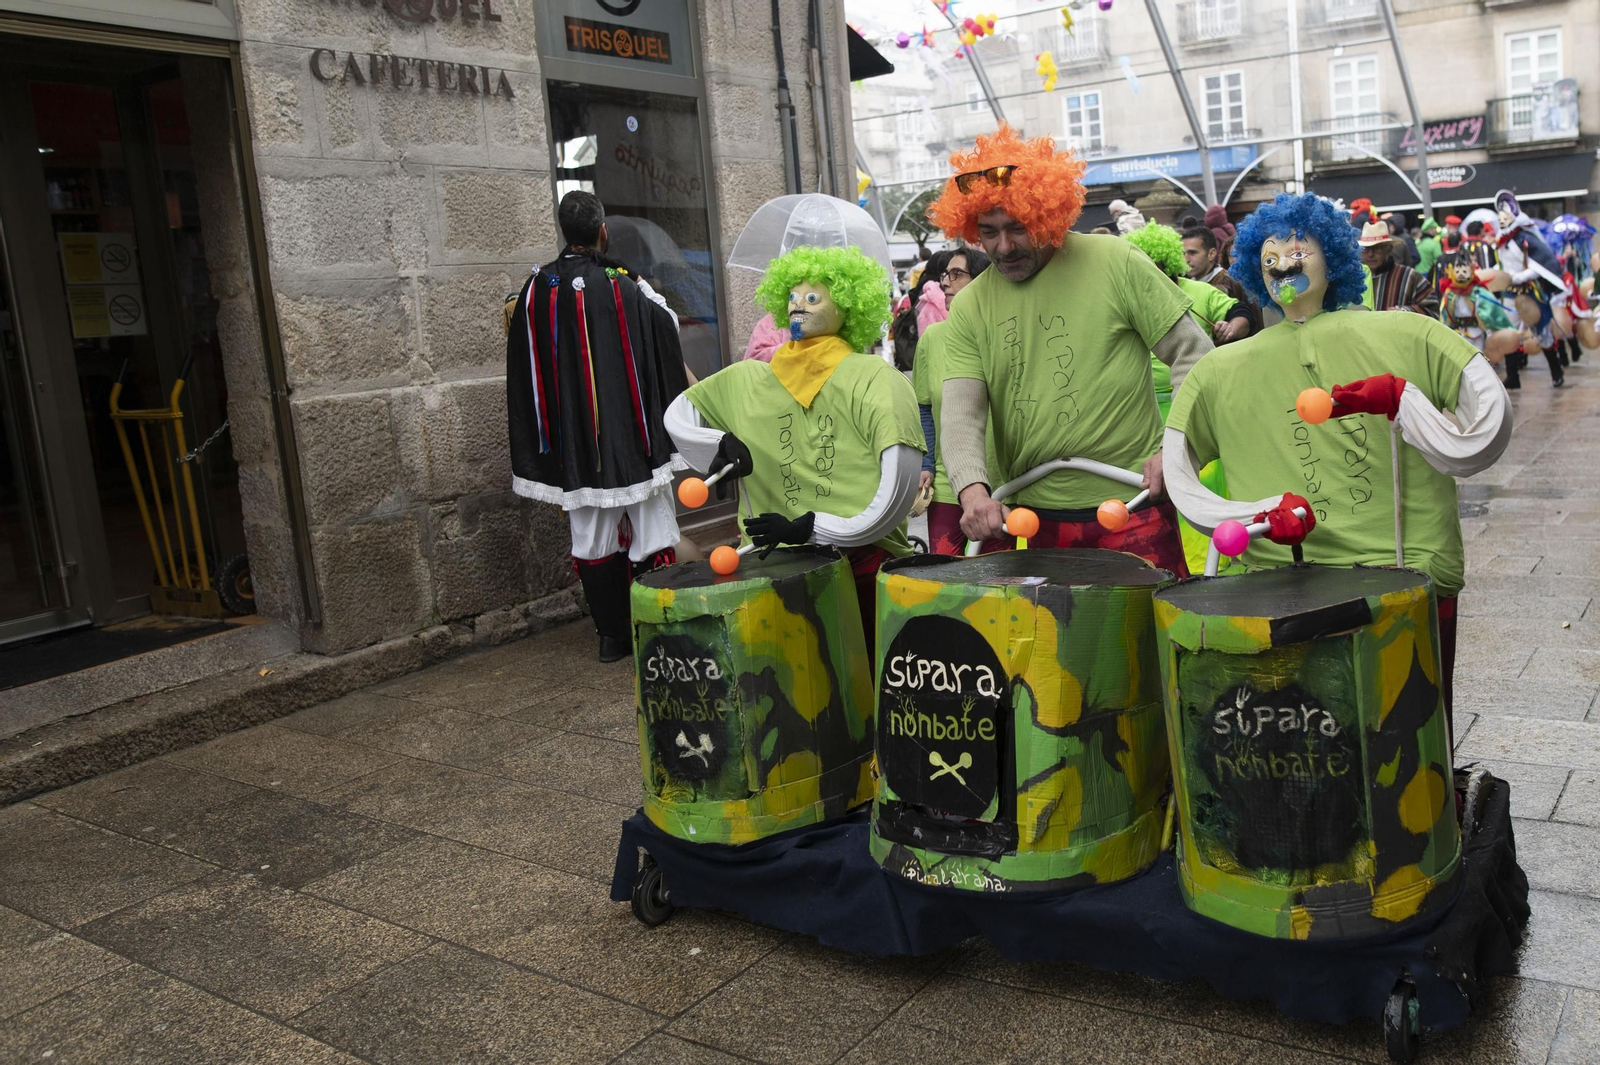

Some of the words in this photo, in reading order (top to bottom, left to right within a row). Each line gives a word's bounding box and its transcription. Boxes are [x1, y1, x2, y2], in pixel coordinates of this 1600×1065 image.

[568, 24, 669, 59] TRISQUEL
[309, 48, 516, 99] CAFETERIA
[890, 696, 996, 741] nonbate
